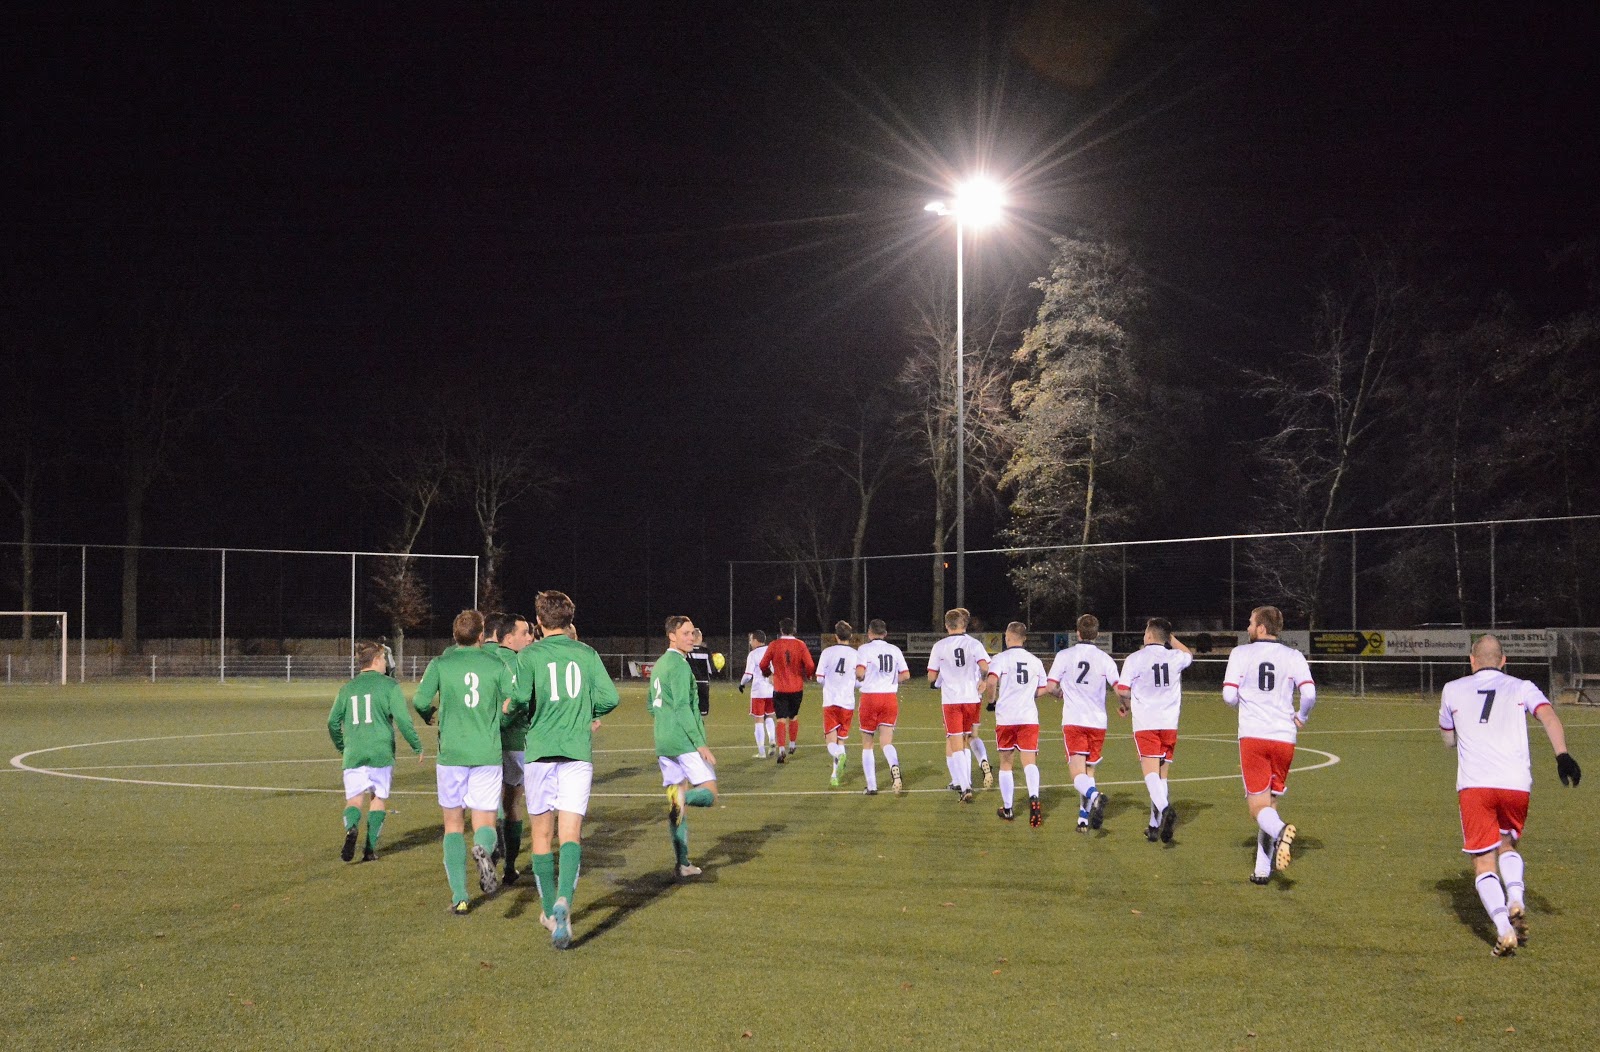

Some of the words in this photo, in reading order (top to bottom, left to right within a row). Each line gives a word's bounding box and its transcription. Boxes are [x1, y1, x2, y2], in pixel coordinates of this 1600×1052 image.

[835, 657, 846, 676] 4
[877, 654, 894, 674] 10
[954, 647, 966, 667] 9
[547, 661, 582, 701] 10
[1016, 662, 1029, 685] 5
[1075, 661, 1091, 684] 2
[1151, 663, 1170, 687] 11
[1258, 662, 1275, 692] 6
[464, 672, 480, 708] 3
[652, 677, 663, 708] 2
[350, 694, 373, 725] 11
[1477, 689, 1496, 723] 7
